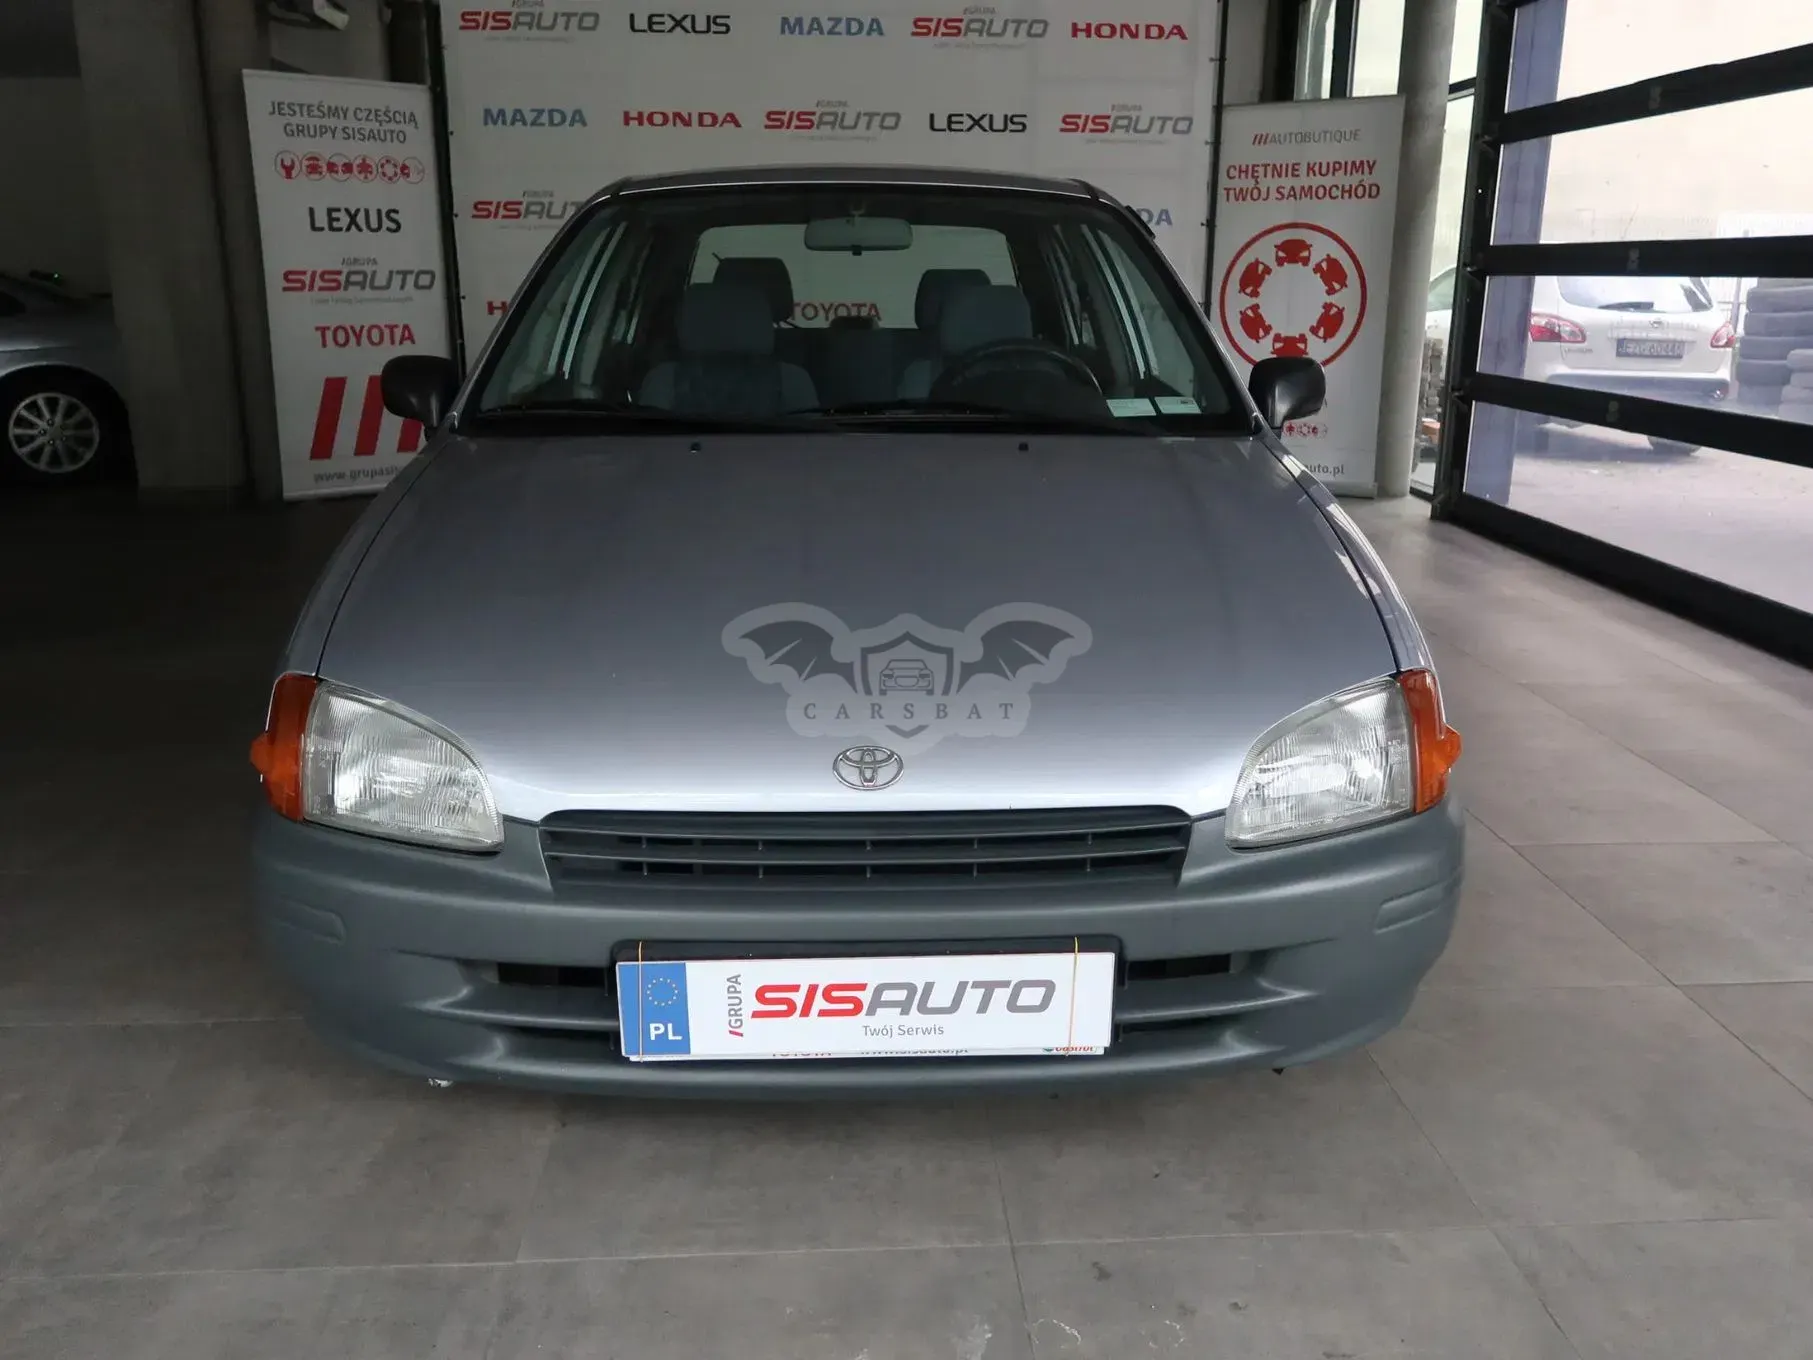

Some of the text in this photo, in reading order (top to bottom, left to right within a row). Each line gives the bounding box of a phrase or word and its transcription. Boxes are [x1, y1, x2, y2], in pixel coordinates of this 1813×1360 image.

[459, 11, 600, 31] SISAUTO
[630, 13, 731, 35] LEXUS
[780, 16, 885, 36] MAZDA
[911, 17, 1049, 38] SISAUTO
[1071, 22, 1188, 40] HONDA
[269, 100, 419, 129] JESTEŚMY CZĘŚCIĄ
[483, 108, 587, 127] MAZDA
[622, 111, 742, 128] HONDA
[764, 110, 902, 130] SISAUTO
[929, 113, 1027, 133] LEXUS
[1059, 114, 1193, 135] SISAUTO
[283, 122, 407, 144] GRUPY SISAUTO
[1226, 159, 1378, 185] CHĘTNIE KUPIMY
[1223, 179, 1381, 203] TWÓJ SAMOCHÓD
[308, 206, 402, 234] LEXUS
[471, 200, 588, 219] SISAUT
[281, 269, 436, 293] SISAUTO
[314, 323, 416, 349] TOYOTA
[750, 979, 1057, 1019] SISAUTO
[649, 1022, 683, 1041] PL
[862, 1024, 945, 1038] Twój Serwis
